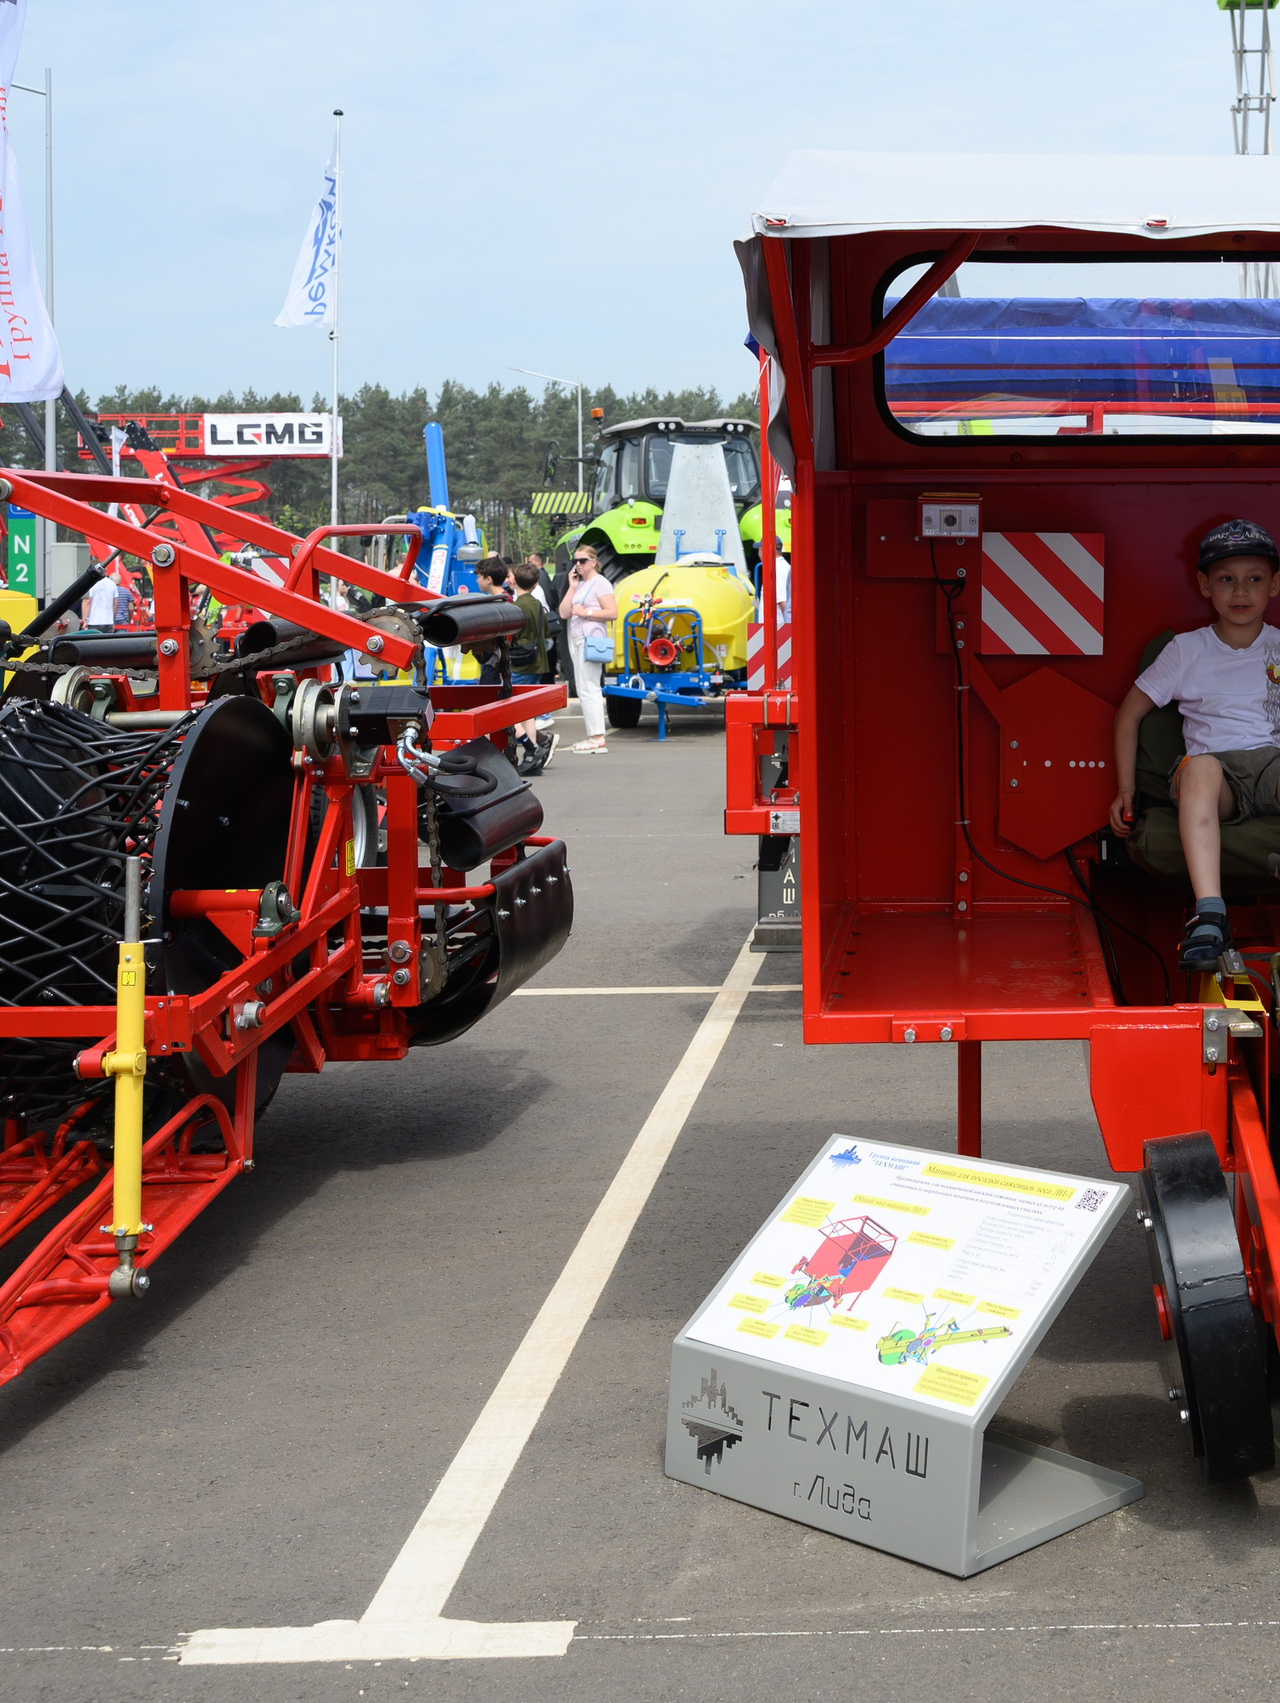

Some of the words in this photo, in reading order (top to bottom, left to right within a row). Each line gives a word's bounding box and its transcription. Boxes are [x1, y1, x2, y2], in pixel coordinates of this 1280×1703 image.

[14, 535, 30, 554] N
[16, 563, 29, 582] 2
[927, 1166, 957, 1176] Машина
[956, 1172, 969, 1180] для
[970, 1176, 999, 1184] посадки
[999, 1181, 1034, 1191] саженцев
[762, 1390, 931, 1480] ТЕХМАШ
[792, 1480, 803, 1499] г.
[807, 1474, 874, 1522] Лида
